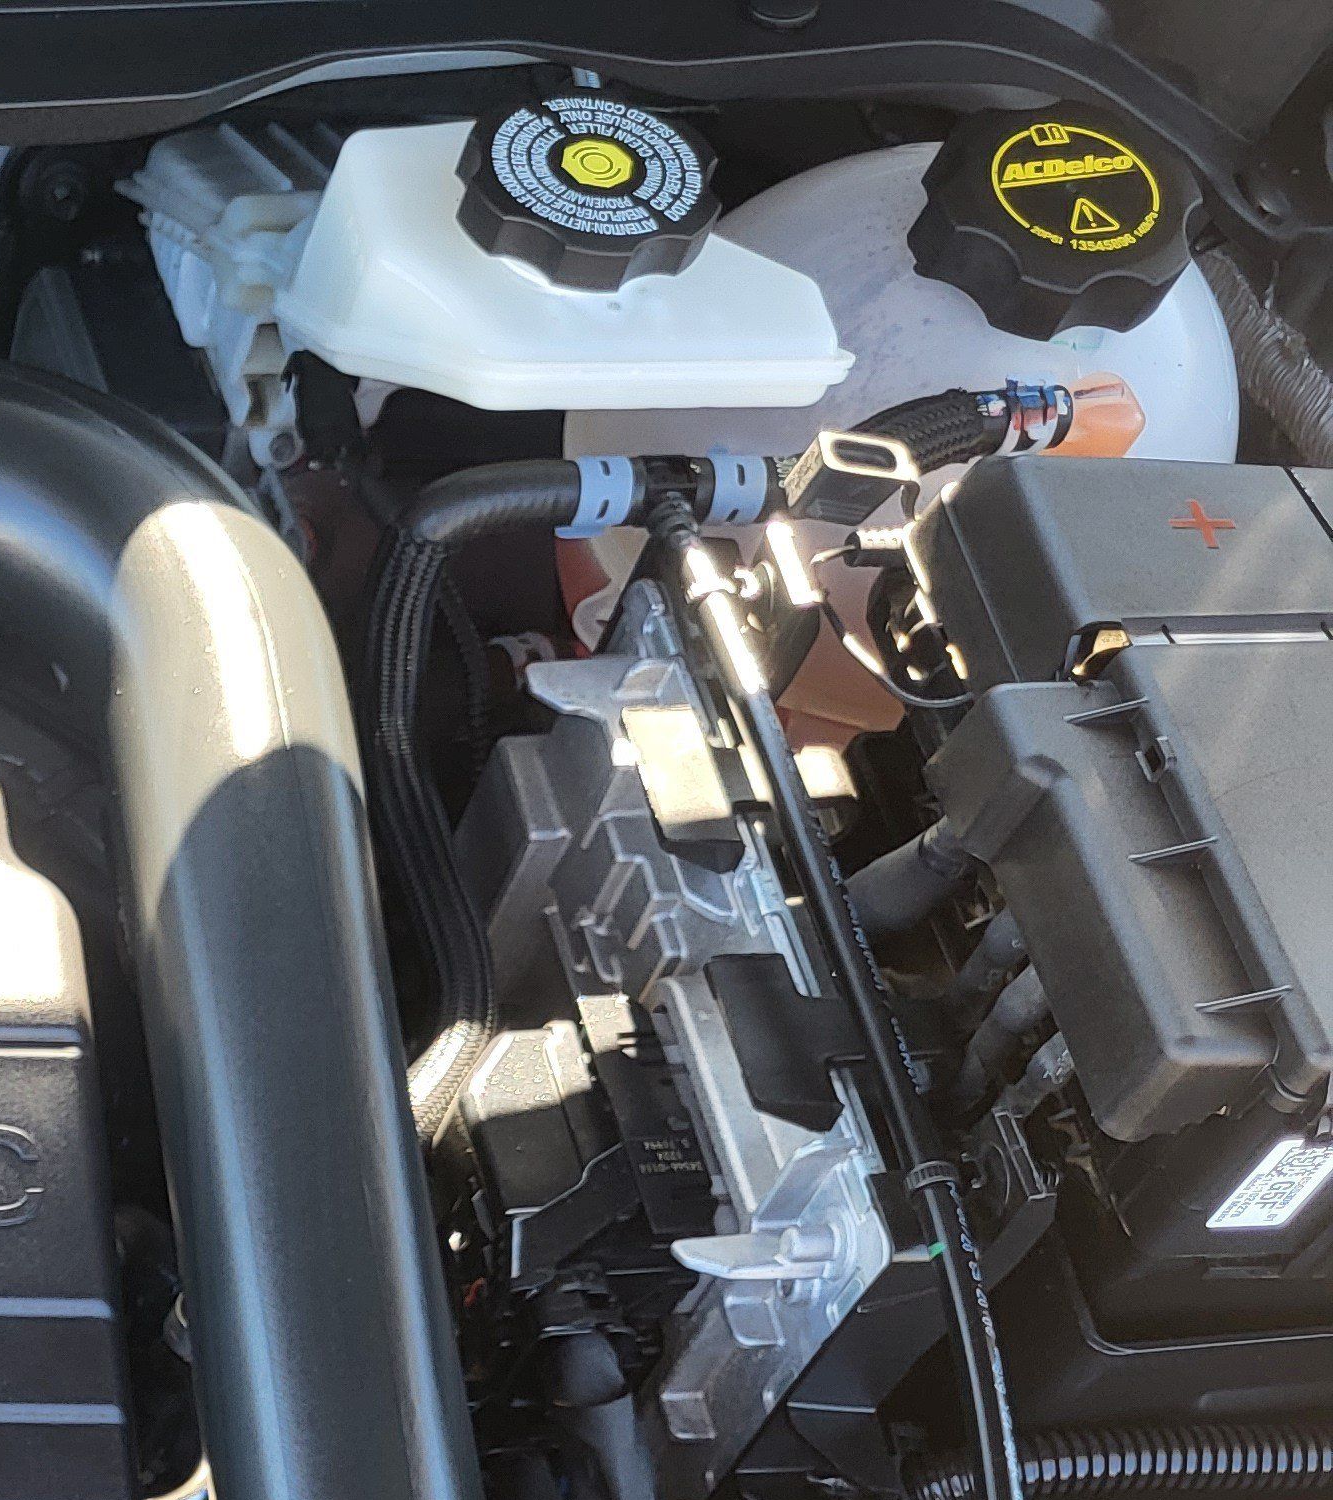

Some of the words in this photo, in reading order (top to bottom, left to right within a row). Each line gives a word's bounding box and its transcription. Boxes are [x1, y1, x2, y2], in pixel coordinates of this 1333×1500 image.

[522, 119, 550, 137] DOT
[555, 112, 592, 125] ONLY
[594, 113, 620, 128] USE
[624, 107, 676, 139] SEALED
[567, 125, 613, 139] FILLER
[617, 119, 676, 159] REMOVING
[611, 130, 653, 157] CLEAN
[511, 152, 528, 164] DE
[671, 142, 701, 170] FROM
[660, 158, 682, 195] BEFORE
[1002, 154, 1134, 181] ACDelco
[491, 160, 526, 198] BOUCHON
[681, 170, 702, 199] FLUID
[514, 194, 537, 208] LE
[533, 190, 557, 205] DU
[549, 198, 577, 215] QUE
[560, 189, 636, 209] PROVENANT
[646, 190, 676, 212] CAP
[527, 202, 590, 233] NETTOYER
[662, 200, 693, 222] DOT
[1255, 1181, 1296, 1209] G5F
